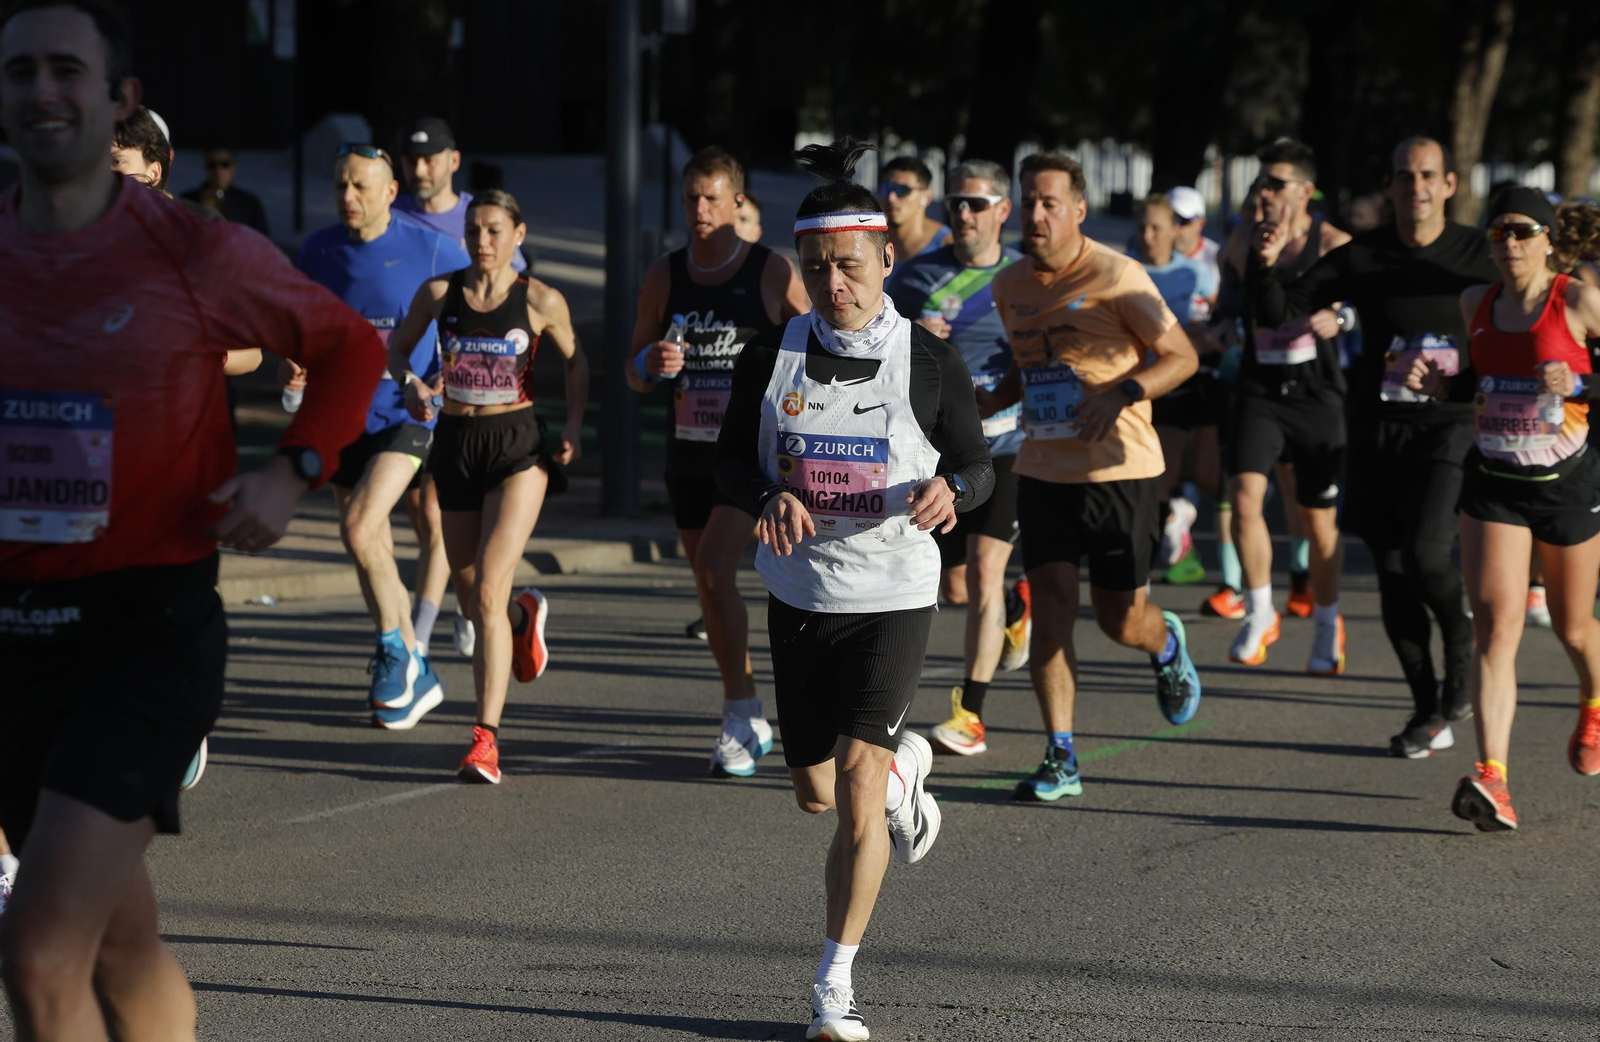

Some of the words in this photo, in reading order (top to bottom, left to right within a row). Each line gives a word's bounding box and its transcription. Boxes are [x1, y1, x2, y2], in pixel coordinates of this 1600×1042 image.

[465, 342, 507, 354] ZURICH
[447, 370, 512, 388] ANGÉLICA
[1030, 370, 1072, 383] ZURICH
[3, 400, 93, 422] ZURICH
[808, 402, 824, 410] NN
[813, 441, 875, 457] ZURICH
[810, 471, 850, 485] 10104
[0, 477, 109, 506] JANDRO
[785, 486, 884, 514] ONGZHAO
